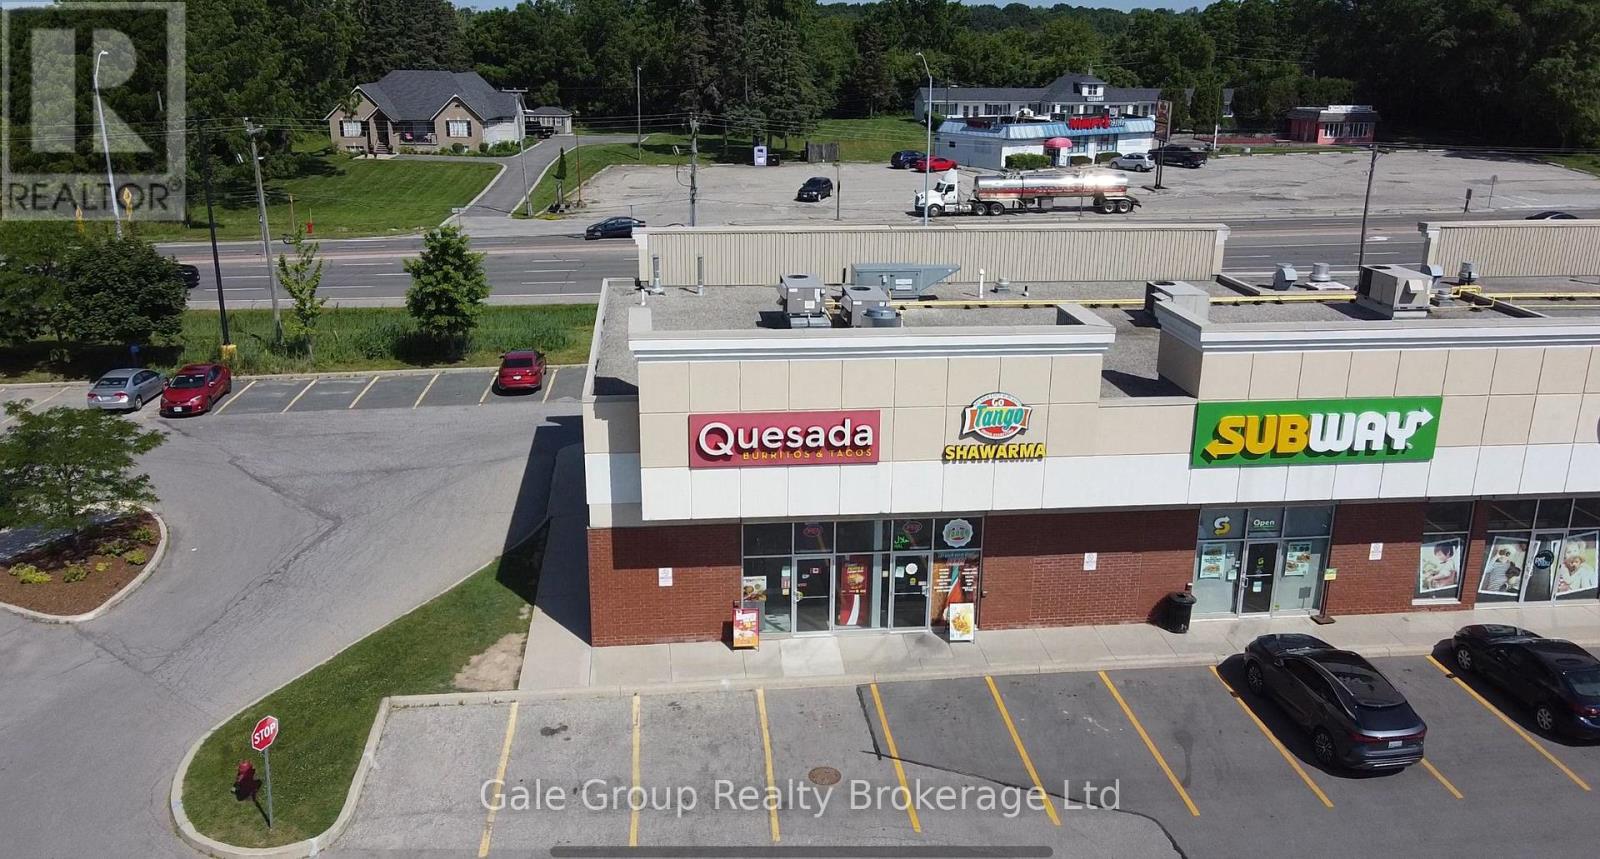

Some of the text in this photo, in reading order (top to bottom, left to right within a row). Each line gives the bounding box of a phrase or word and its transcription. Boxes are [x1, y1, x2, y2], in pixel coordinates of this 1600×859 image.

[992, 398, 1004, 407] GO
[975, 404, 1024, 430] Tango
[699, 418, 873, 456] Quesada
[1205, 408, 1434, 459] SUBWAY
[743, 448, 872, 460] BURRITOS & TACOS
[944, 443, 1046, 461] SHAWARMA
[1253, 519, 1275, 527] Open
[254, 722, 276, 745] STOP
